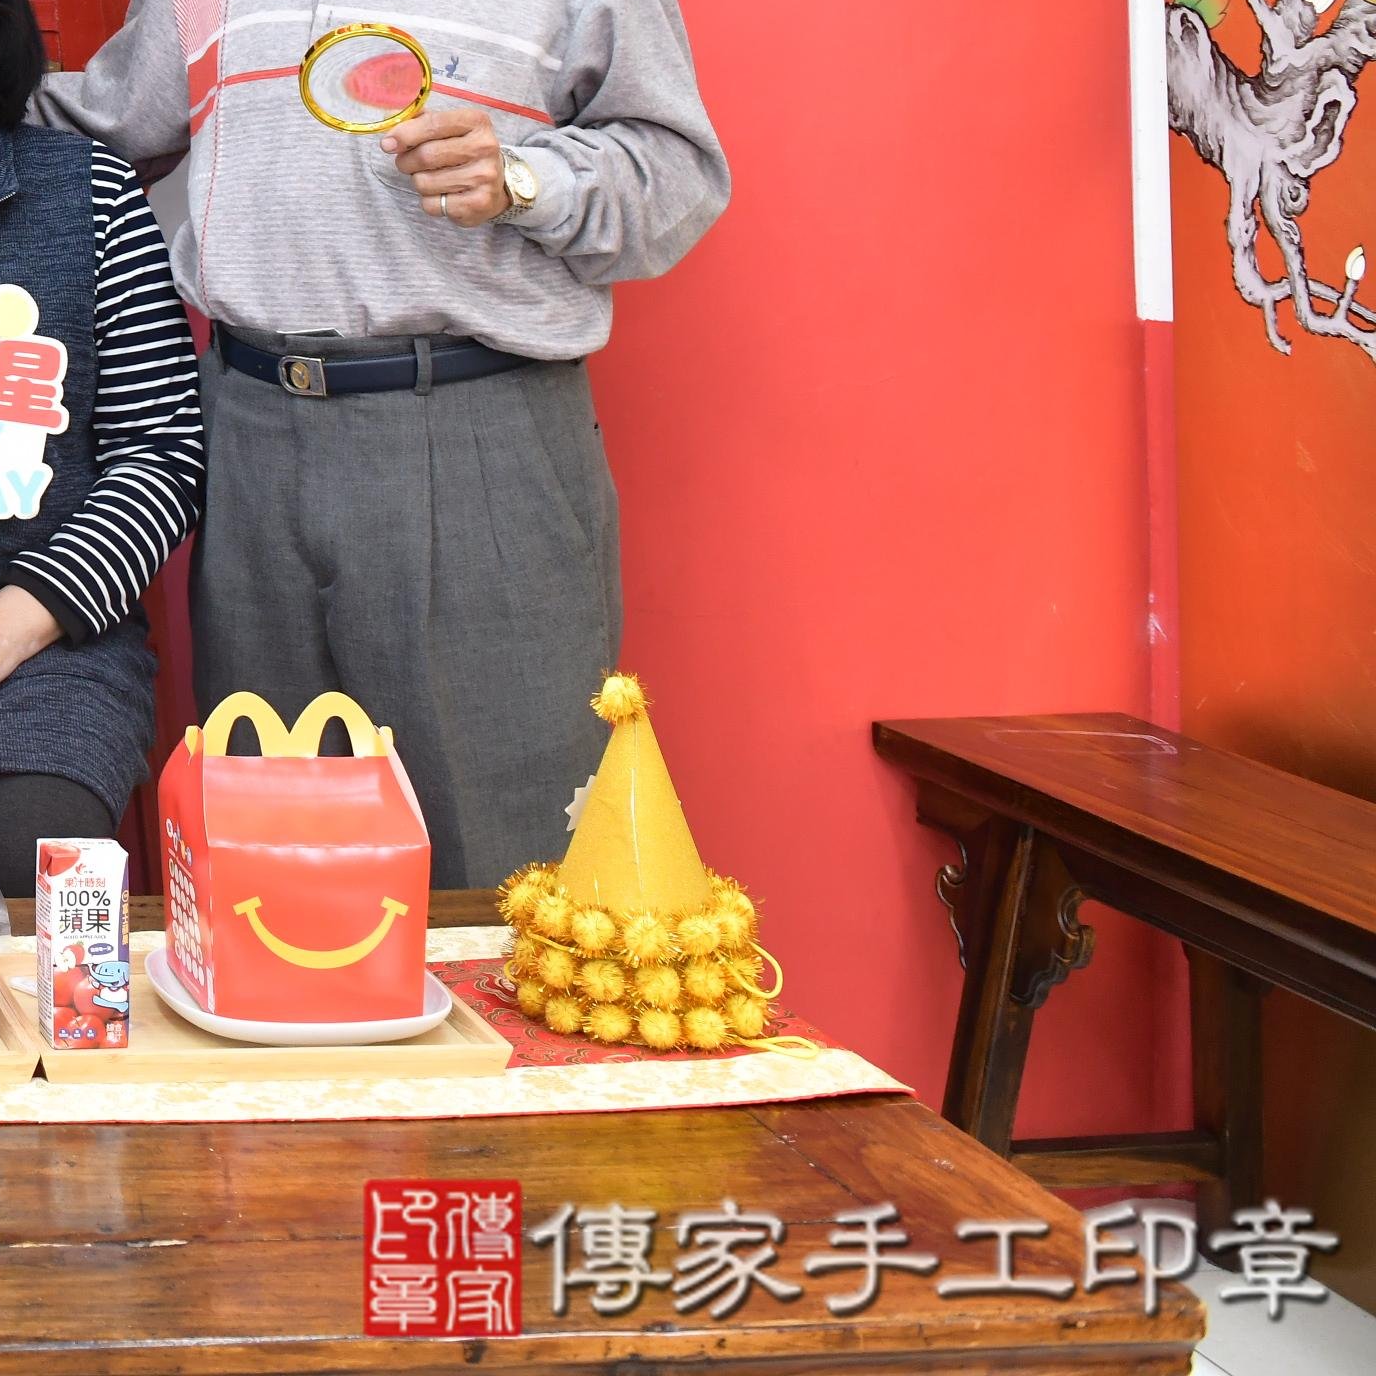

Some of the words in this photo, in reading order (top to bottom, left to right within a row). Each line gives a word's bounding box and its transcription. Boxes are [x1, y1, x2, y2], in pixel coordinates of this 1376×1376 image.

[64, 877, 106, 888] 果汁時刻
[59, 891, 111, 906] 100%
[59, 908, 111, 934] 蘋果
